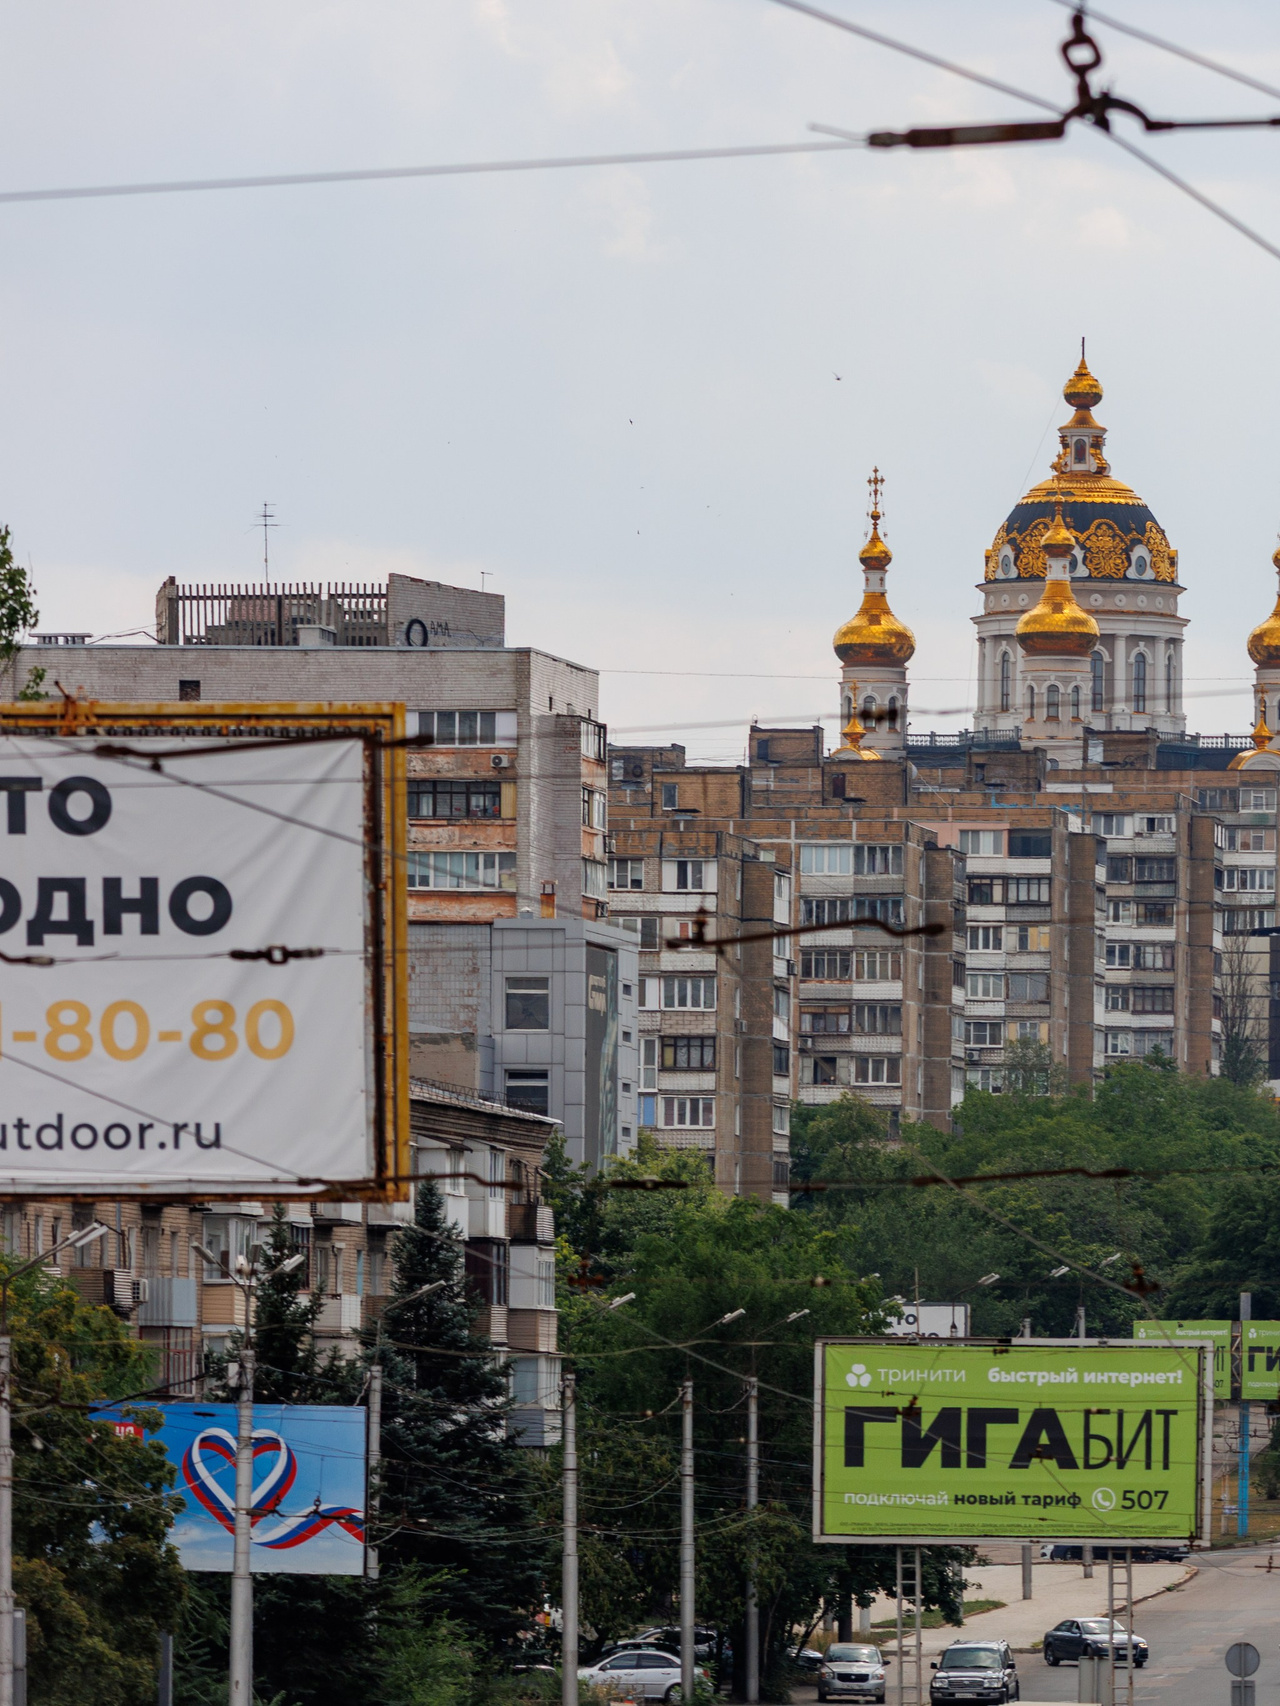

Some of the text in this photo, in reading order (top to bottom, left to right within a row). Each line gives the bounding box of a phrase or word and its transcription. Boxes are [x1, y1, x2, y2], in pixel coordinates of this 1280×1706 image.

[0, 1000, 295, 1061] -80-80
[877, 1367, 1183, 1388] тринити быстрый интернет!
[844, 1406, 1178, 1471] ГИГАБИТ
[844, 1490, 1169, 1510] подключай новый тариф 507
